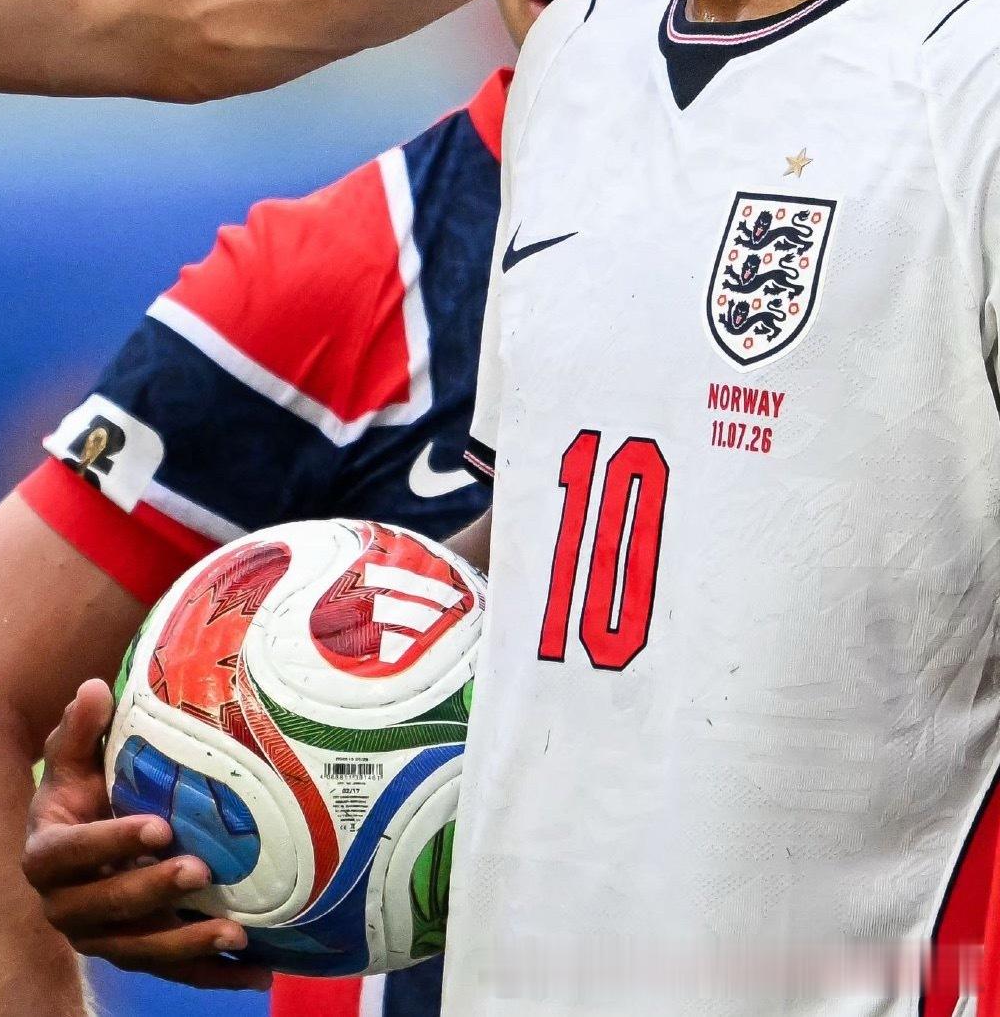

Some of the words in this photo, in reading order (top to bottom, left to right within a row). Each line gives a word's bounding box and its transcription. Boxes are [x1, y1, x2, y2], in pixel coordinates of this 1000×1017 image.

[707, 382, 785, 418] NORWAY
[711, 420, 773, 454] 11.07.26
[537, 428, 670, 671] 10
